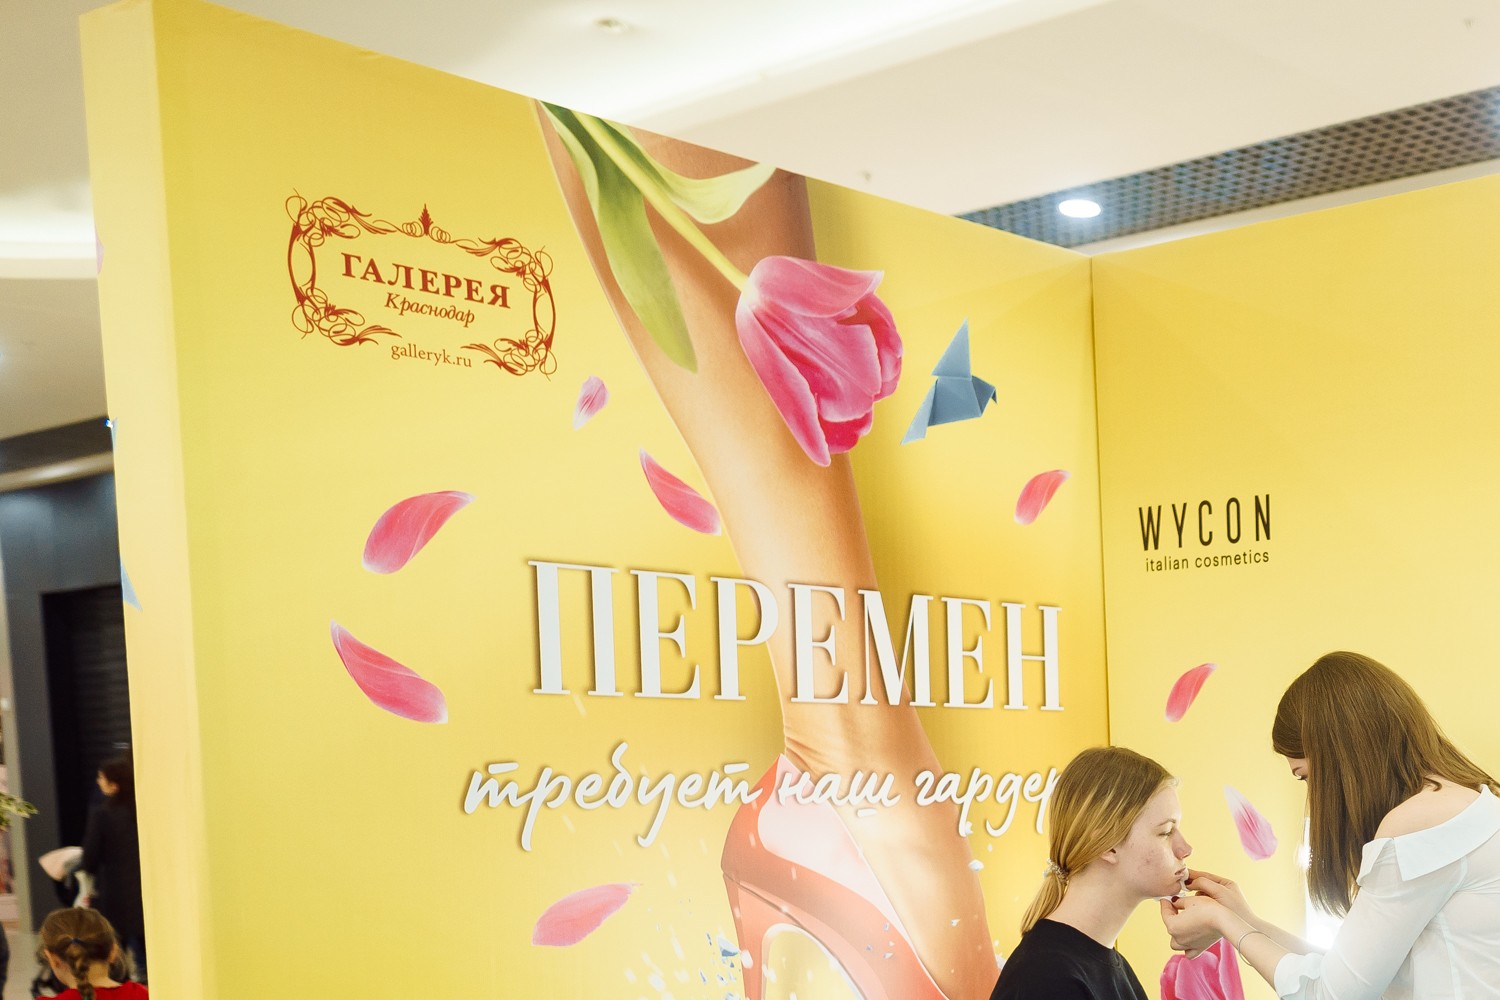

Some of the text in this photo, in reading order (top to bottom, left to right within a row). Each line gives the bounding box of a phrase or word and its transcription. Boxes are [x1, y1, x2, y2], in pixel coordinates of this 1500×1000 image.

[341, 252, 511, 309] ГАЛЕРЕЯ
[384, 292, 475, 328] Краснодар
[391, 344, 472, 367] galleryk.ru
[1138, 494, 1271, 551] WYCON
[1146, 550, 1269, 572] italian cosmetics
[528, 560, 1065, 711] ПЕРЕМЕН
[463, 742, 1061, 852] требует наш гардер
